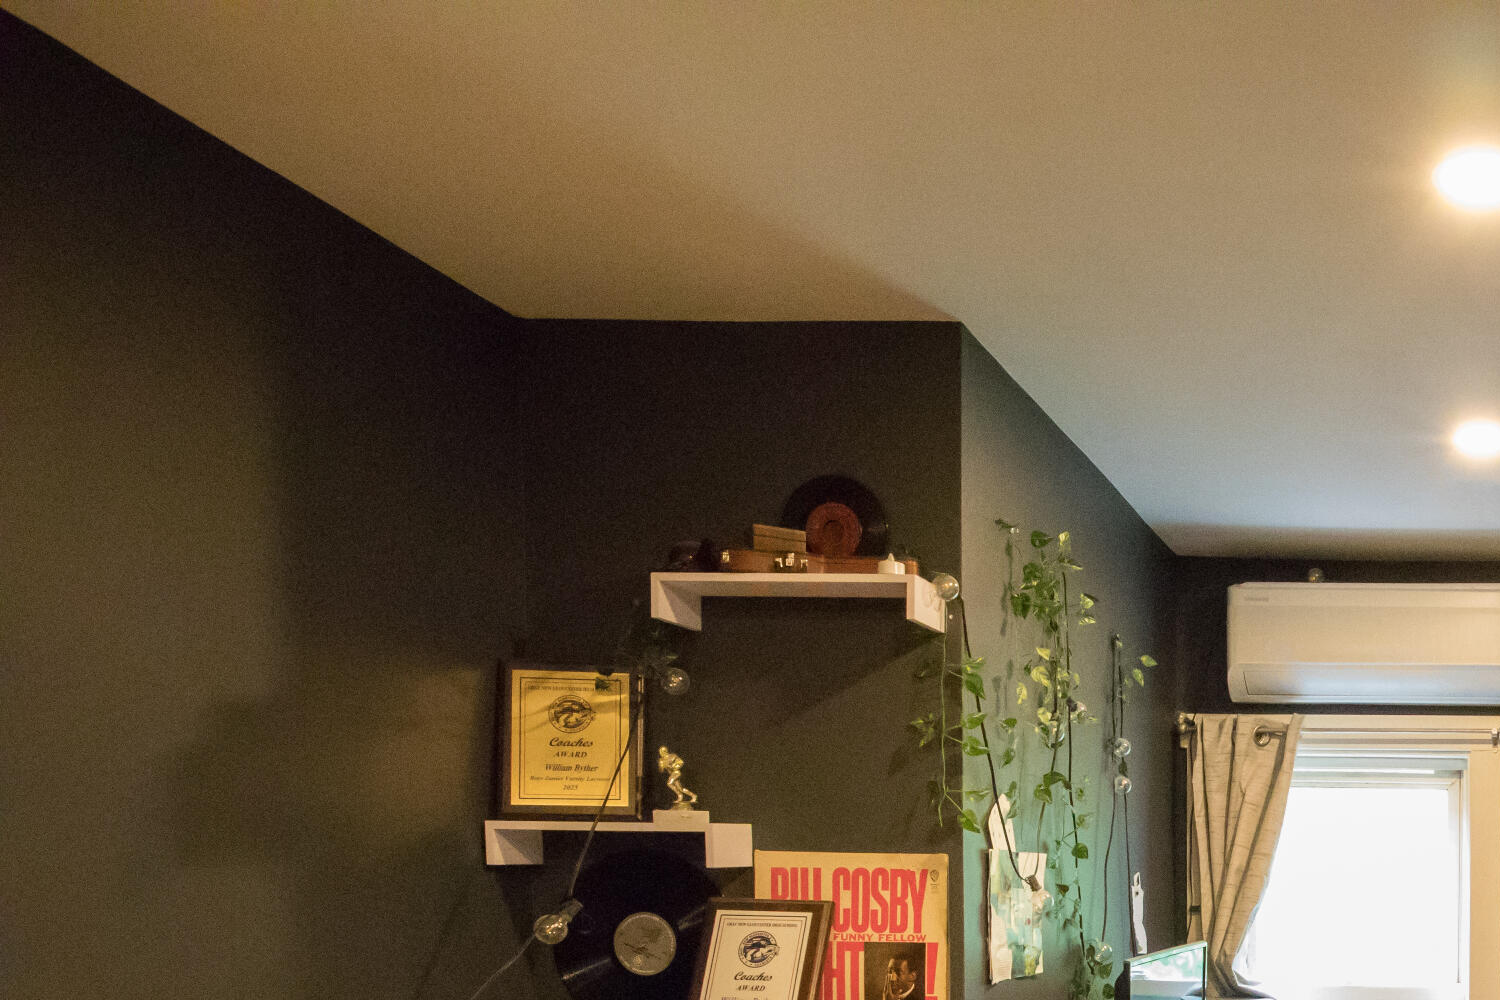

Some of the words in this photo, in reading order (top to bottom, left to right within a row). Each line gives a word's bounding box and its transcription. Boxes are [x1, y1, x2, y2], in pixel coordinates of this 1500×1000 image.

[549, 737, 593, 747] Coaches
[832, 867, 928, 933] COSBY
[833, 933, 873, 941] FUNNY
[879, 934, 927, 942] FELLOW
[734, 971, 773, 982] Coaches
[736, 984, 766, 992] AWARD
